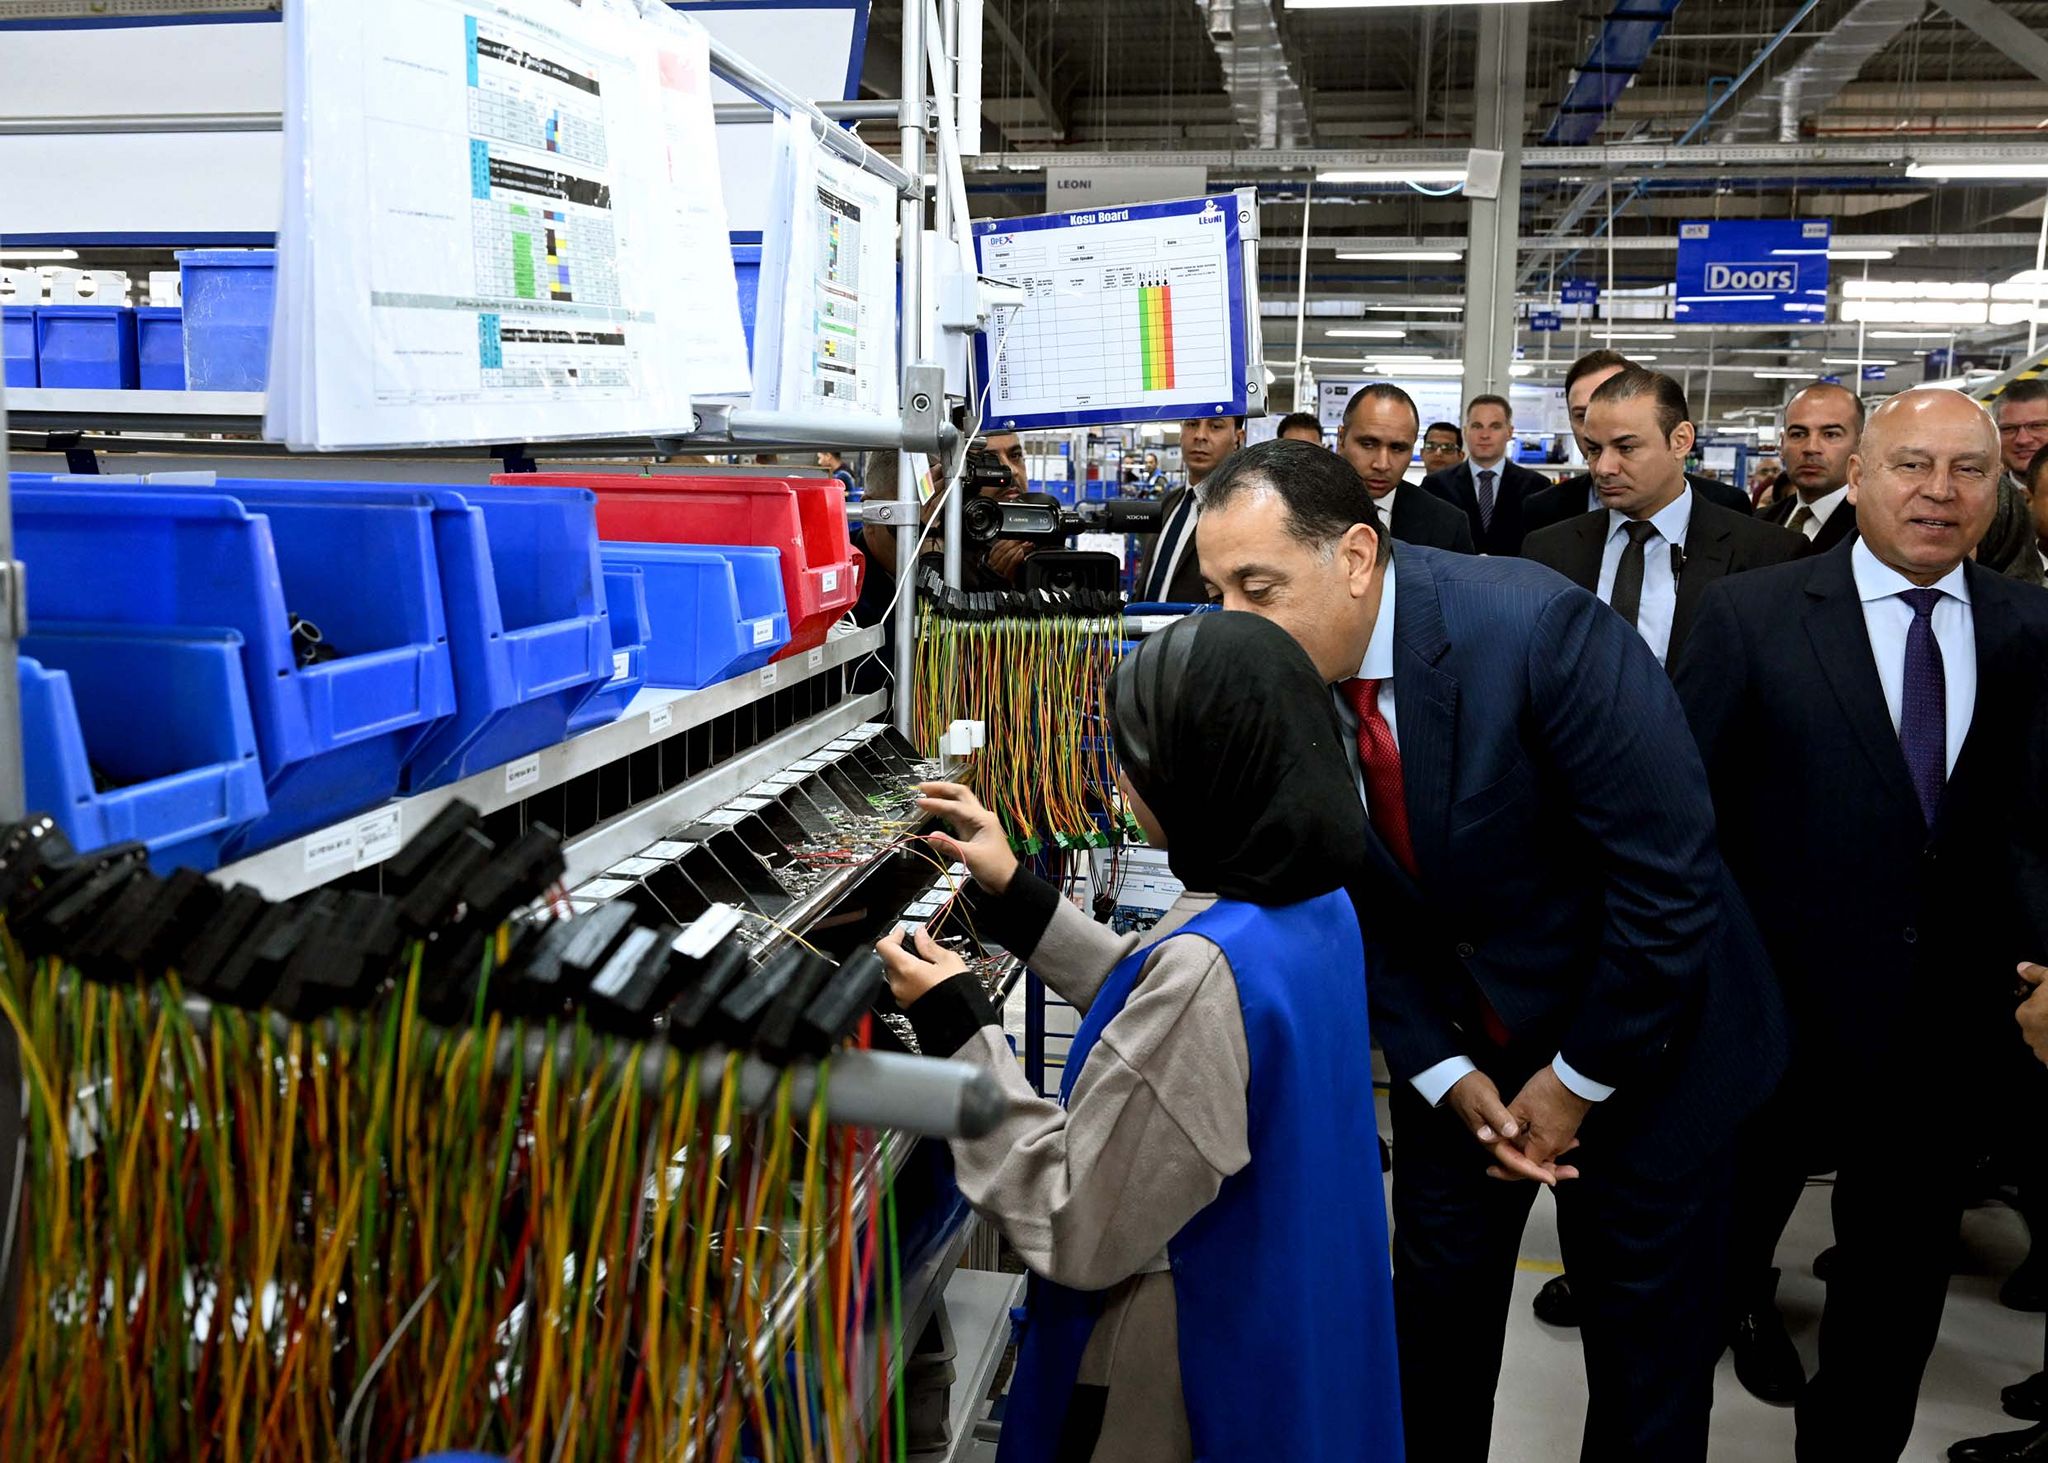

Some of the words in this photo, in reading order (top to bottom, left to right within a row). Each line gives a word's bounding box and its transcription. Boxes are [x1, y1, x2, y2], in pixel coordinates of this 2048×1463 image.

[1057, 180, 1091, 189] LEONI
[1070, 215, 1096, 225] Kosu
[1098, 210, 1128, 222] Board
[1199, 215, 1222, 225] LEONI
[1710, 266, 1791, 289] Doors
